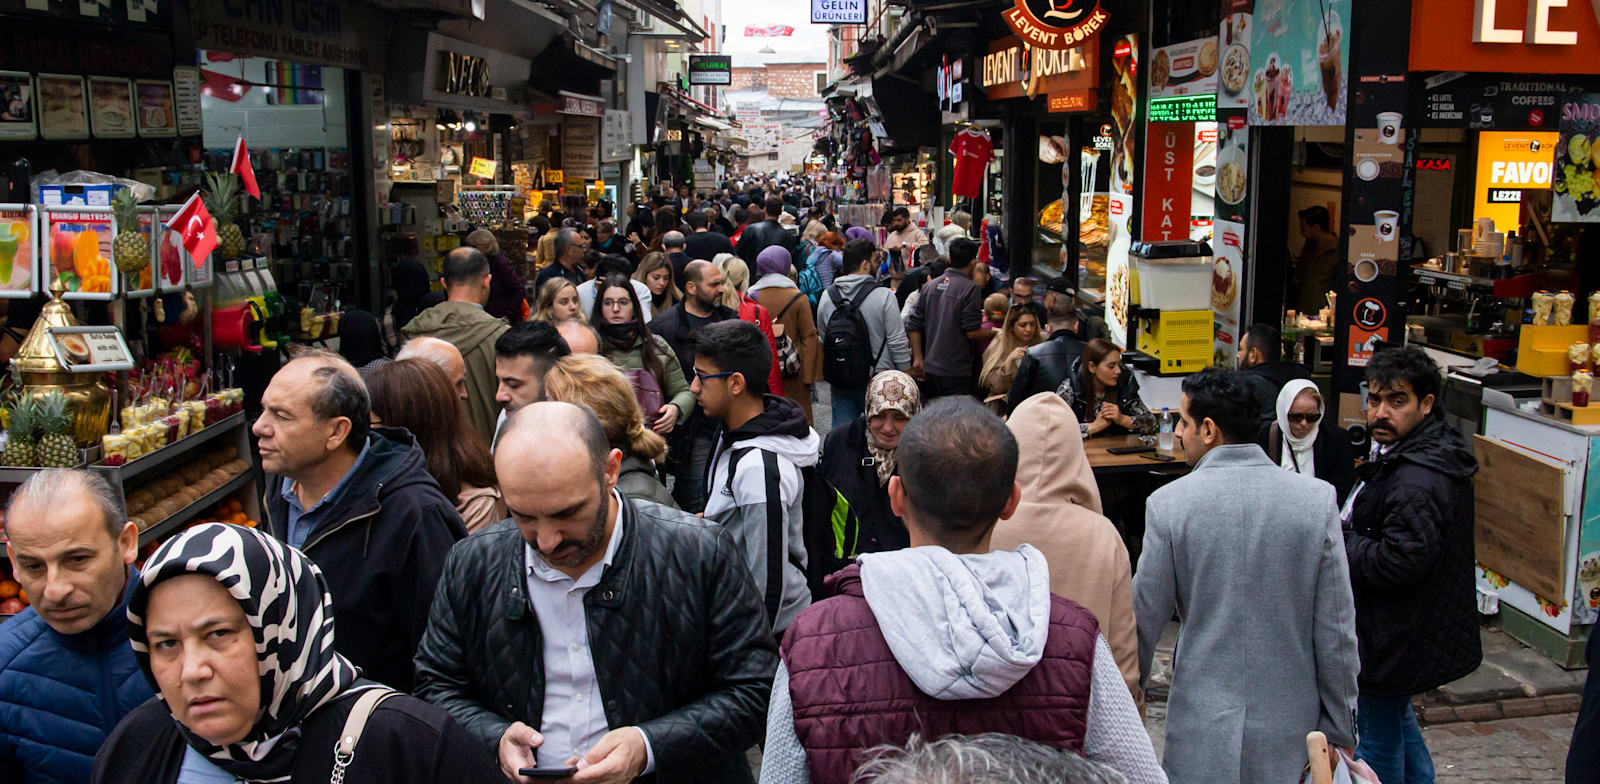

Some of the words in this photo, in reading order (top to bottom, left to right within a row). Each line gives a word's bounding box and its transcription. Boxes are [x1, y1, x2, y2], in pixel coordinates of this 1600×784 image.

[1009, 9, 1058, 46] LEVENT
[1063, 10, 1107, 45] BÖREK
[982, 46, 1018, 88] LEVENT
[1500, 81, 1567, 92] TRADITIONAL
[1511, 95, 1555, 106] COFFEES
[1164, 131, 1176, 182] ÜST
[1415, 159, 1451, 171] KASA
[51, 210, 79, 220] MANGO
[1160, 198, 1175, 242] KAT
